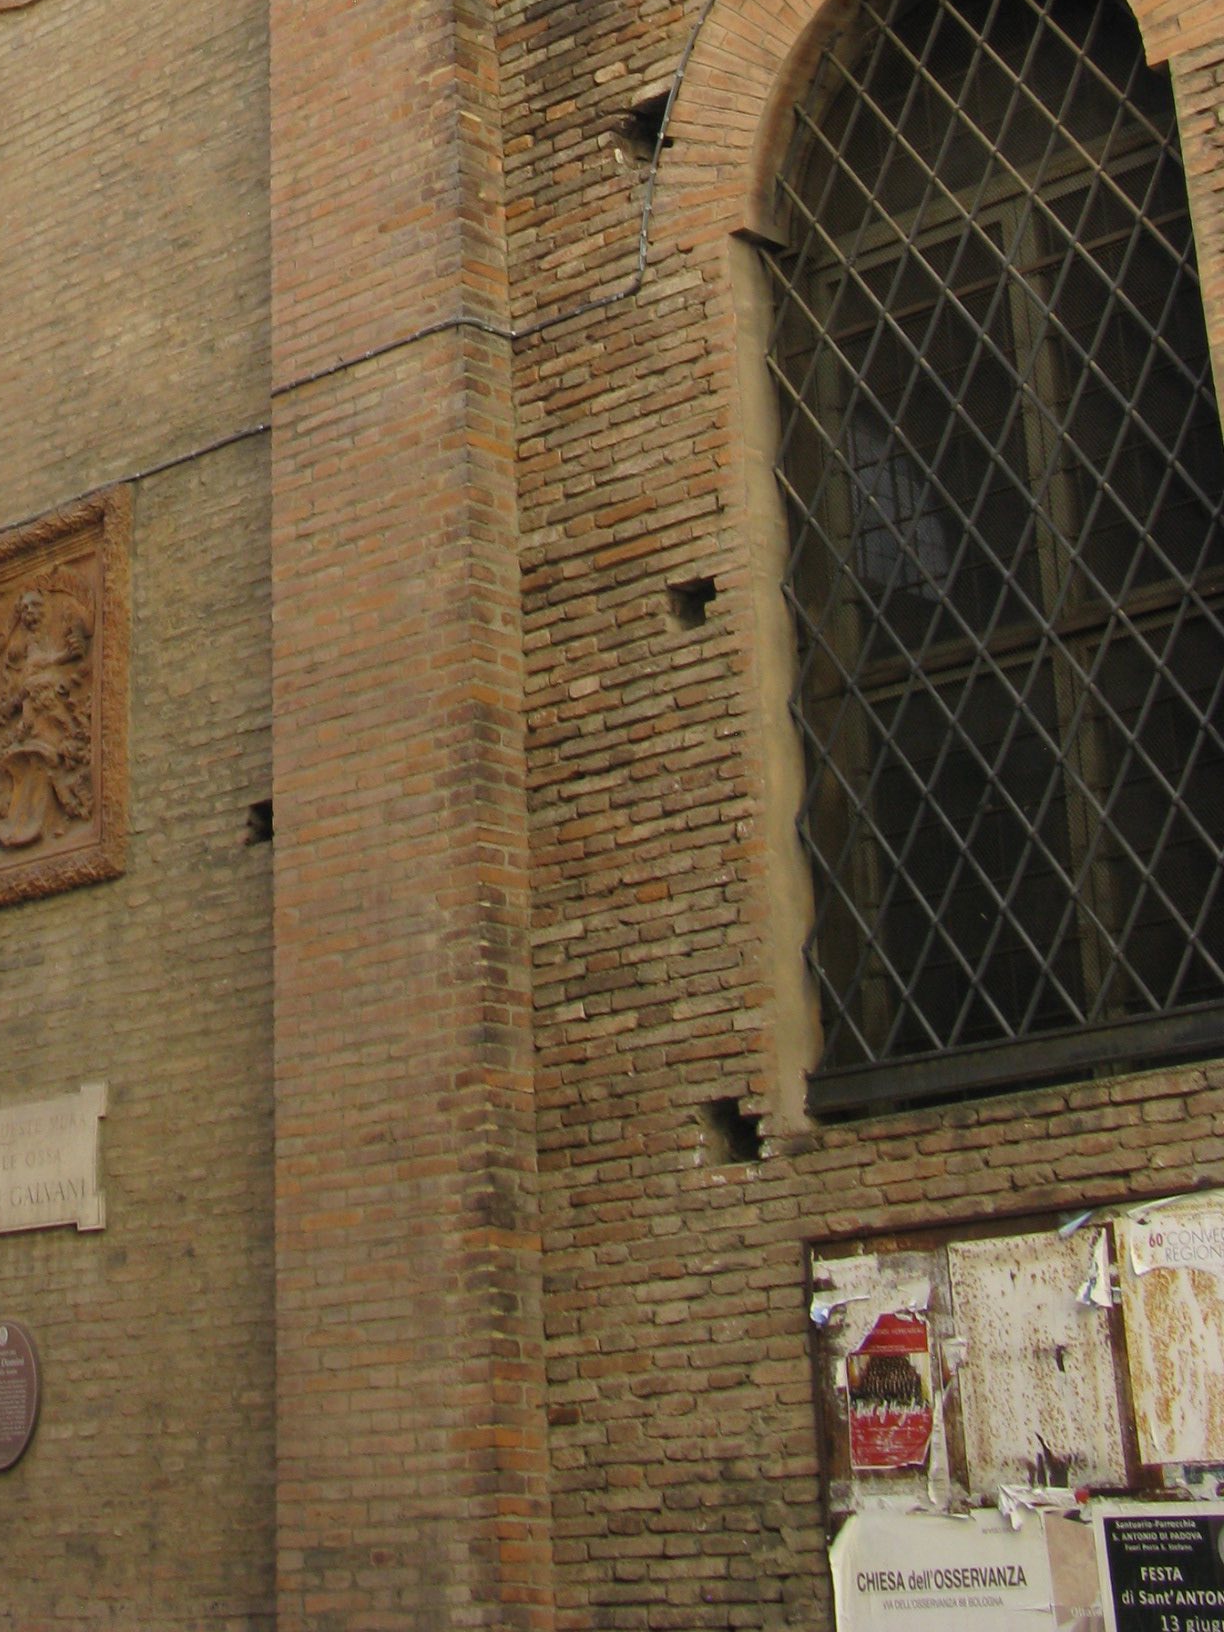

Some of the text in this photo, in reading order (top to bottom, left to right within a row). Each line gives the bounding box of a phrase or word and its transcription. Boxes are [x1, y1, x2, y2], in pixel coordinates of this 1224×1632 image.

[2, 1154, 17, 1171] LE
[25, 1148, 62, 1167] OSSA
[10, 1177, 86, 1207] GALVANI
[1167, 1226, 1224, 1246] CONVE
[1165, 1243, 1224, 1262] REGION
[1122, 1531, 1157, 1541] ANTONIO
[1159, 1531, 1168, 1540] DI
[1170, 1531, 1203, 1541] PADOVA
[856, 1565, 1027, 1593] CHIESA dell'OSSERVANZA
[1140, 1566, 1183, 1582] FESTA
[883, 1599, 894, 1610] VIA
[968, 1596, 1004, 1608] BOLOGNA
[1122, 1590, 1135, 1605] di
[1161, 1615, 1224, 1632] 13 giug
